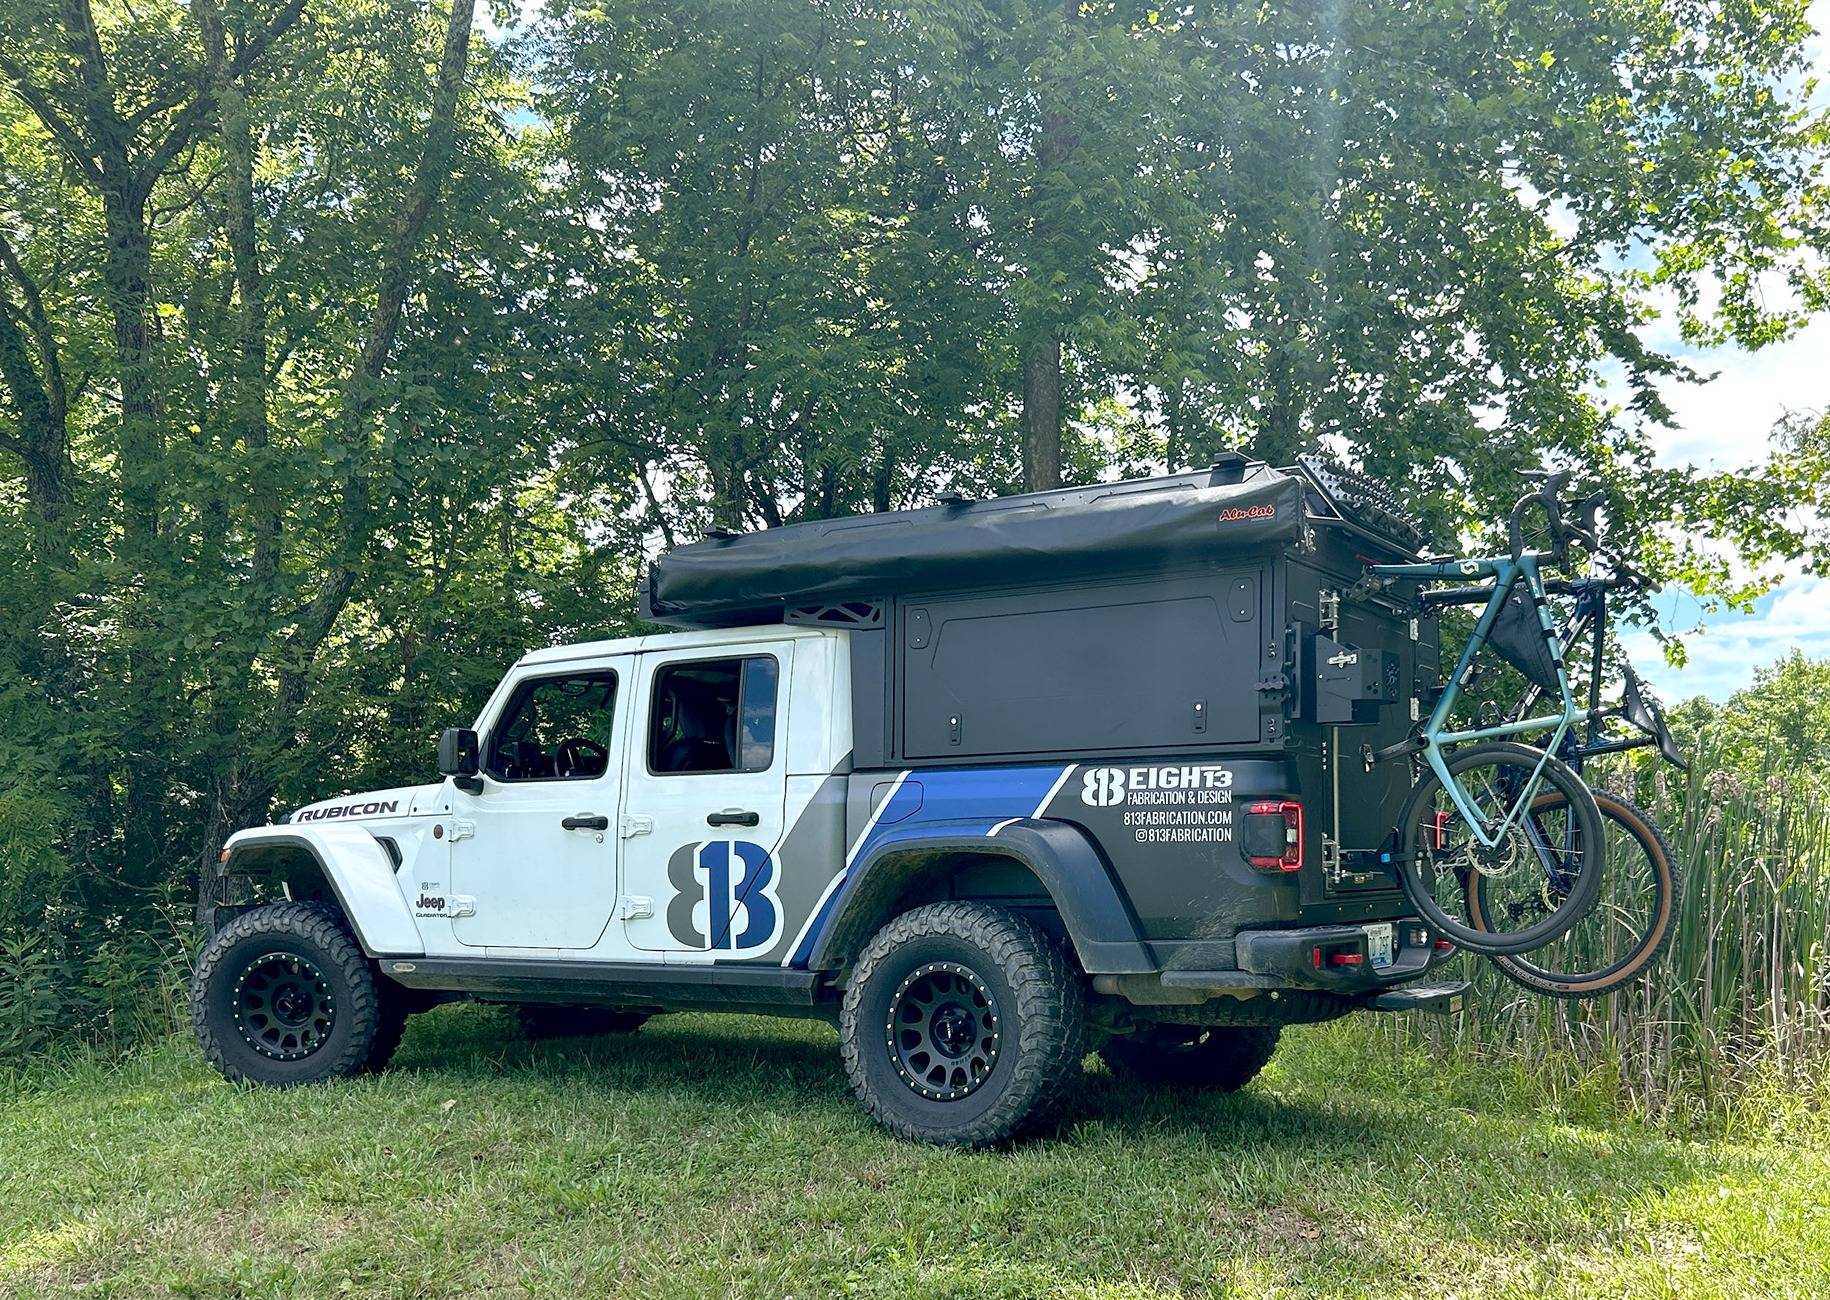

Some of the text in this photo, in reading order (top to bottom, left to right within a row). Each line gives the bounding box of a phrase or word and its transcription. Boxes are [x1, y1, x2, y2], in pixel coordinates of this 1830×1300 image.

[1220, 504, 1275, 521] Alu-Cab
[1127, 790, 1232, 805] FABRICATION & DESIGN
[297, 800, 399, 822] RUBICON
[1123, 810, 1232, 826] 813FABRICATION.COM
[1148, 828, 1232, 842] 813FABRICATION
[415, 893, 445, 911] Jeep
